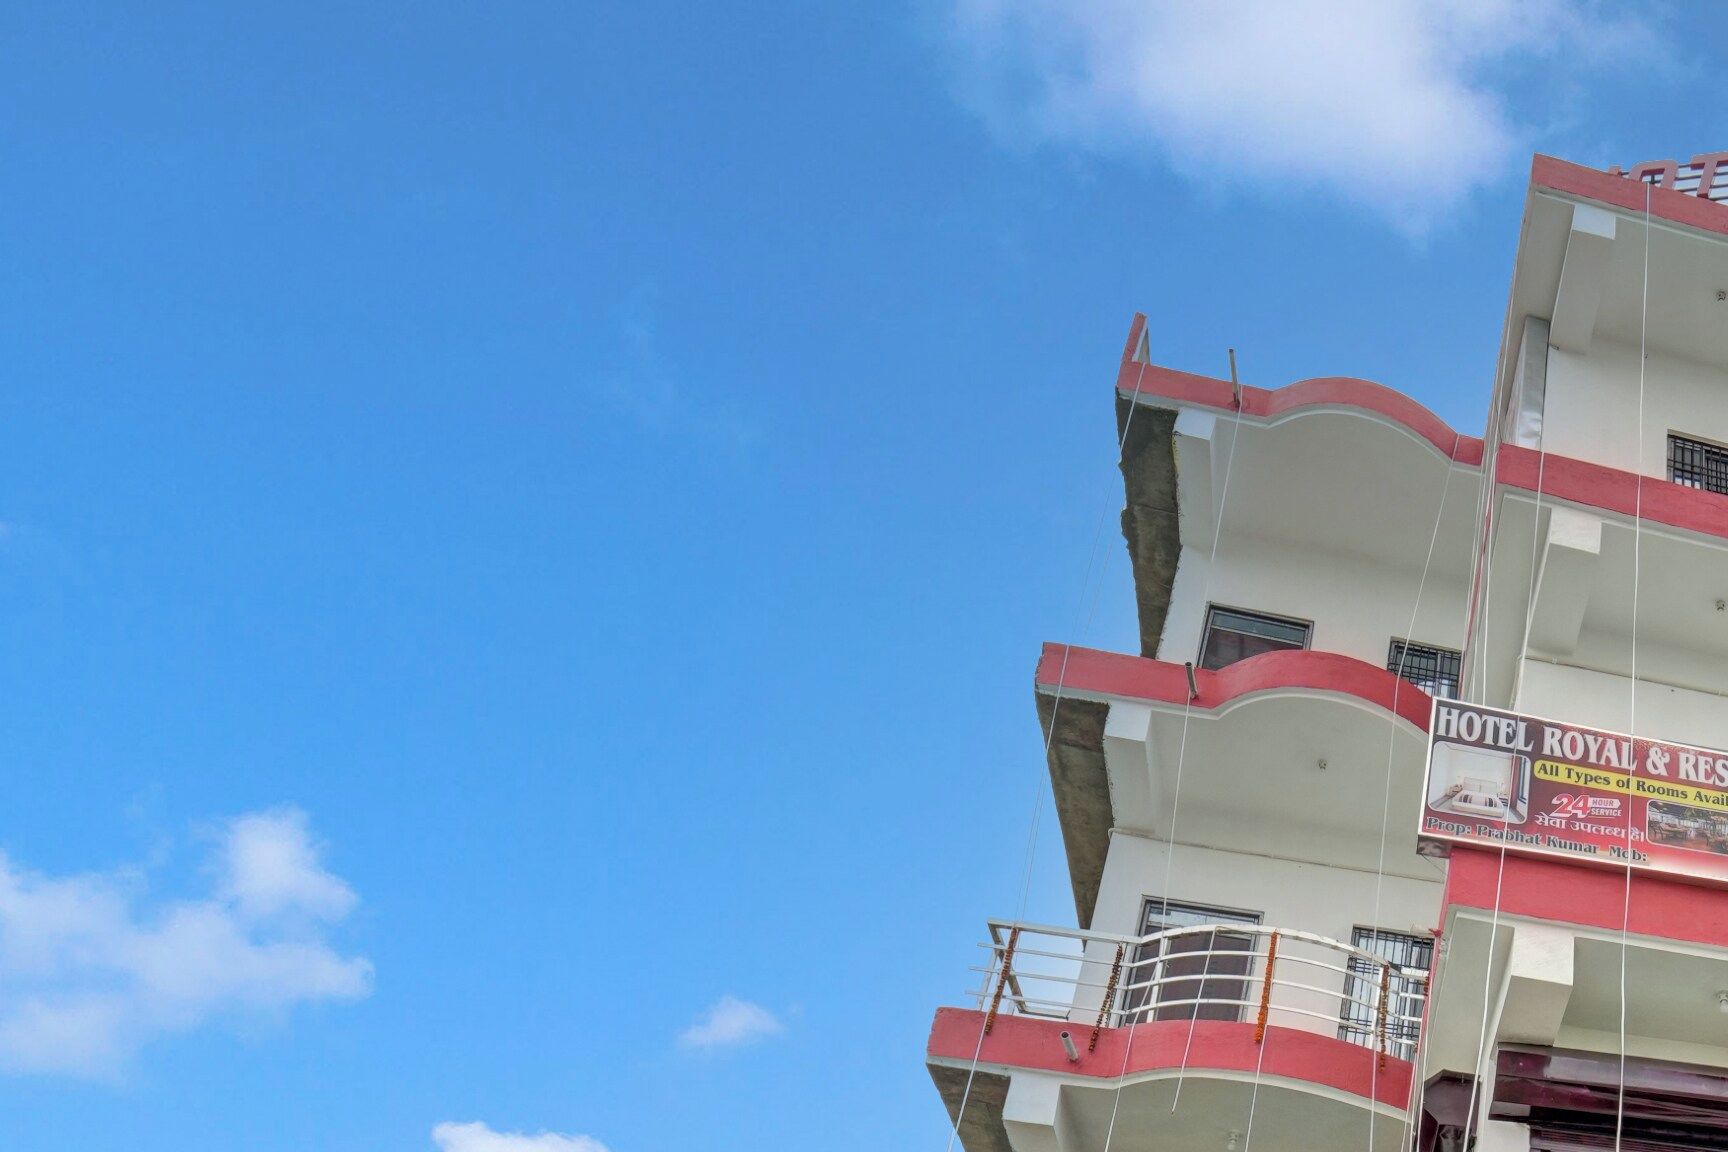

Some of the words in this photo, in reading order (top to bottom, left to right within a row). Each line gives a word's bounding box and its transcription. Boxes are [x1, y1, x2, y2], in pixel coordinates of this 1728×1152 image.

[1436, 705, 1535, 752] HOTEL
[1541, 725, 1638, 771] ROYAL
[1646, 747, 1671, 777] &
[1537, 763, 1559, 777] All
[1565, 767, 1611, 786] Types
[1616, 776, 1632, 790] of
[1636, 780, 1688, 799] Rooms
[1549, 793, 1590, 819] 24
[1591, 799, 1615, 807] HOUR
[1591, 808, 1622, 817] SERVICE
[1425, 816, 1472, 836] Prop:
[1476, 824, 1541, 846] Prabhat
[1546, 835, 1600, 854] Kumar
[1534, 811, 1567, 829] सेवा
[1570, 820, 1627, 839] उपलब्ध
